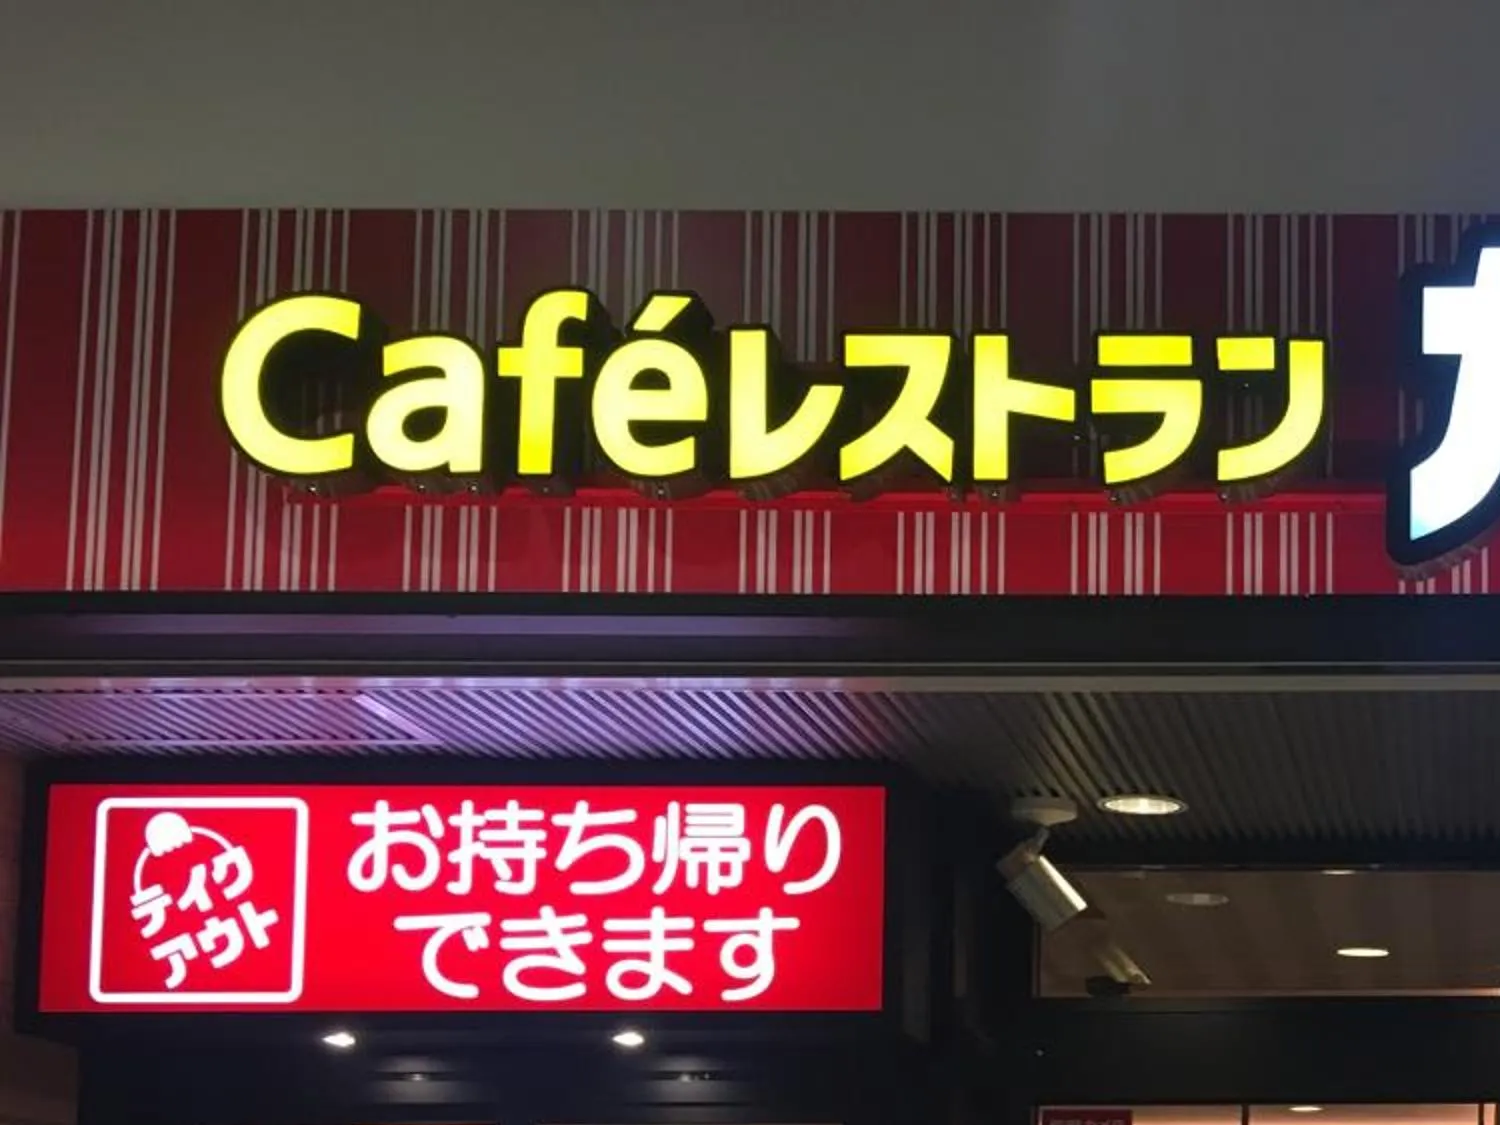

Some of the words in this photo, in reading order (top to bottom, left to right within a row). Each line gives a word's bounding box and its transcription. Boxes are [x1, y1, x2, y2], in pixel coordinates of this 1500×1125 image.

[222, 288, 1326, 484] Caféレストラン
[130, 845, 254, 937] テイク
[346, 802, 841, 897] お持ち帰り
[150, 900, 280, 988] アウト
[394, 910, 800, 1001] できます
